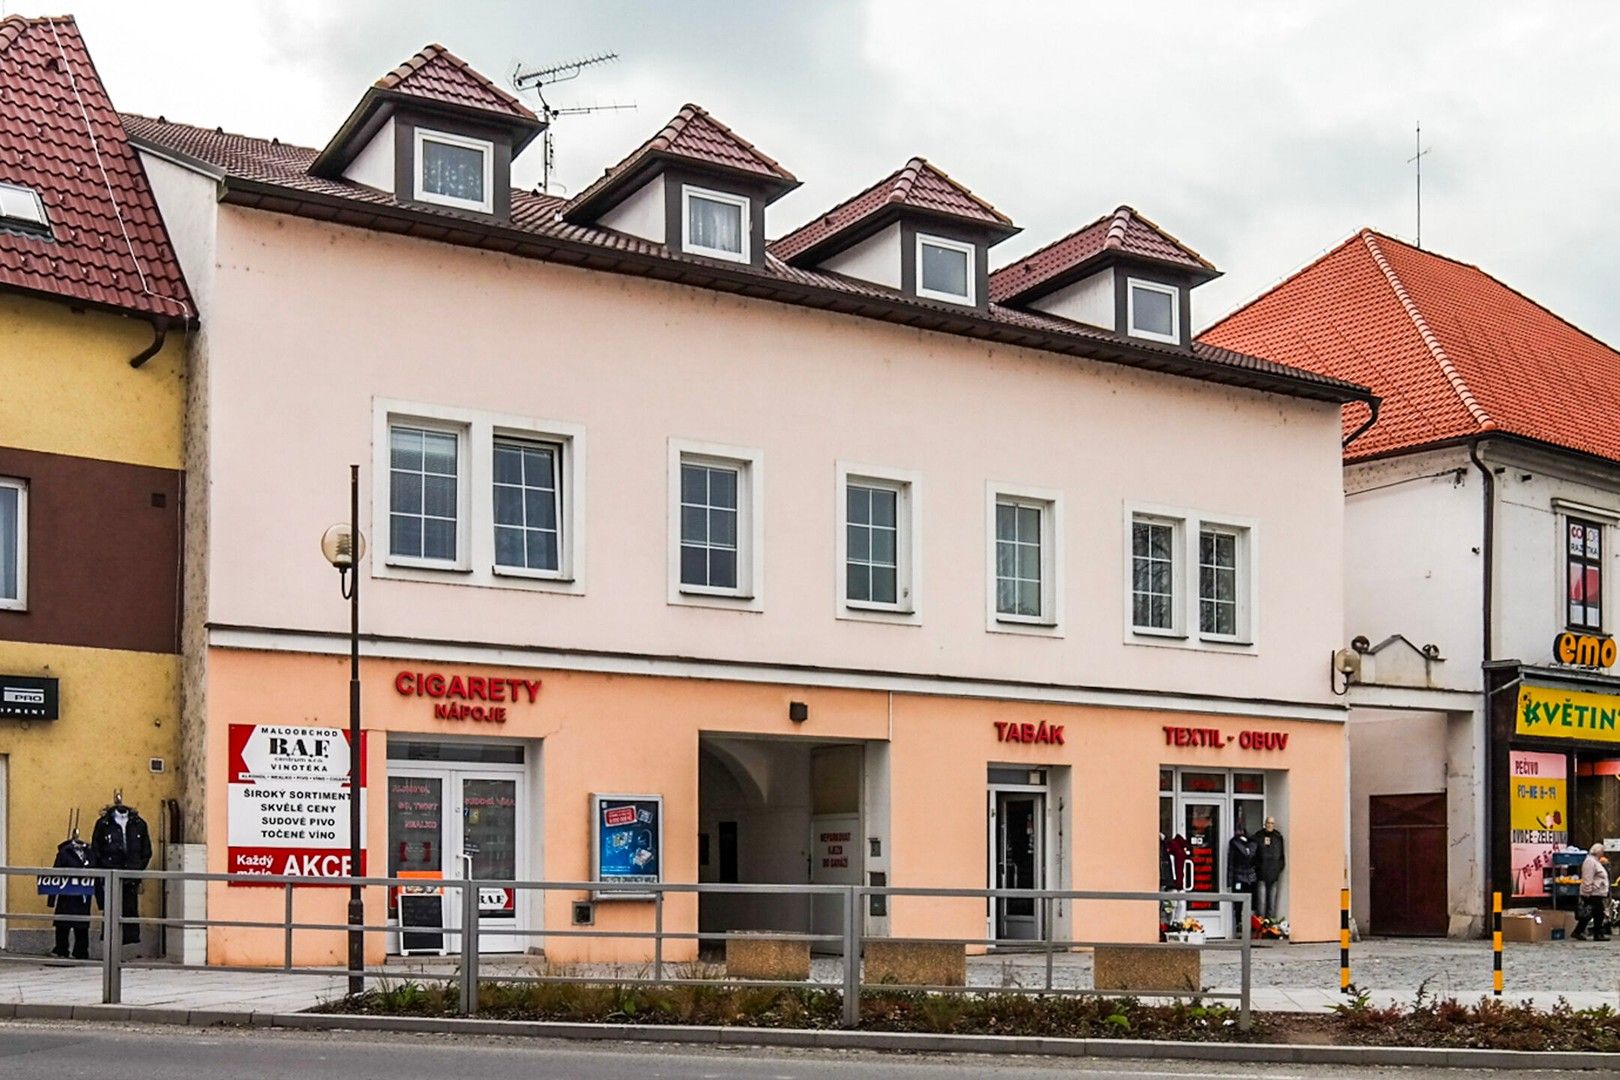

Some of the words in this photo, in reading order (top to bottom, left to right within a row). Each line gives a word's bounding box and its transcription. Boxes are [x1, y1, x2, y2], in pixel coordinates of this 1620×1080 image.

[1558, 631, 1617, 668] emo
[395, 671, 542, 703] CIGARETY
[15, 694, 42, 702] PRO
[434, 701, 507, 723] NÁPOJE
[1523, 698, 1620, 730] KVĚTIN
[261, 727, 338, 737] MALOOBCHOD
[994, 720, 1065, 745] TABÁK
[1162, 726, 1225, 749] TEXTIL
[1239, 730, 1289, 750] OBUV
[269, 737, 329, 758] B.A.F.
[270, 763, 328, 772] VINOTÉKA
[244, 788, 286, 798] ŠIROKÝ
[289, 790, 351, 801] SORTIMENT
[307, 804, 336, 813] CENY
[261, 816, 307, 826] SUDOVÉ
[309, 818, 336, 827] PIVO
[261, 829, 305, 839] TOČENÉ
[308, 830, 336, 840] VÍNO
[236, 854, 274, 869] Každý
[282, 854, 352, 878] AKCE
